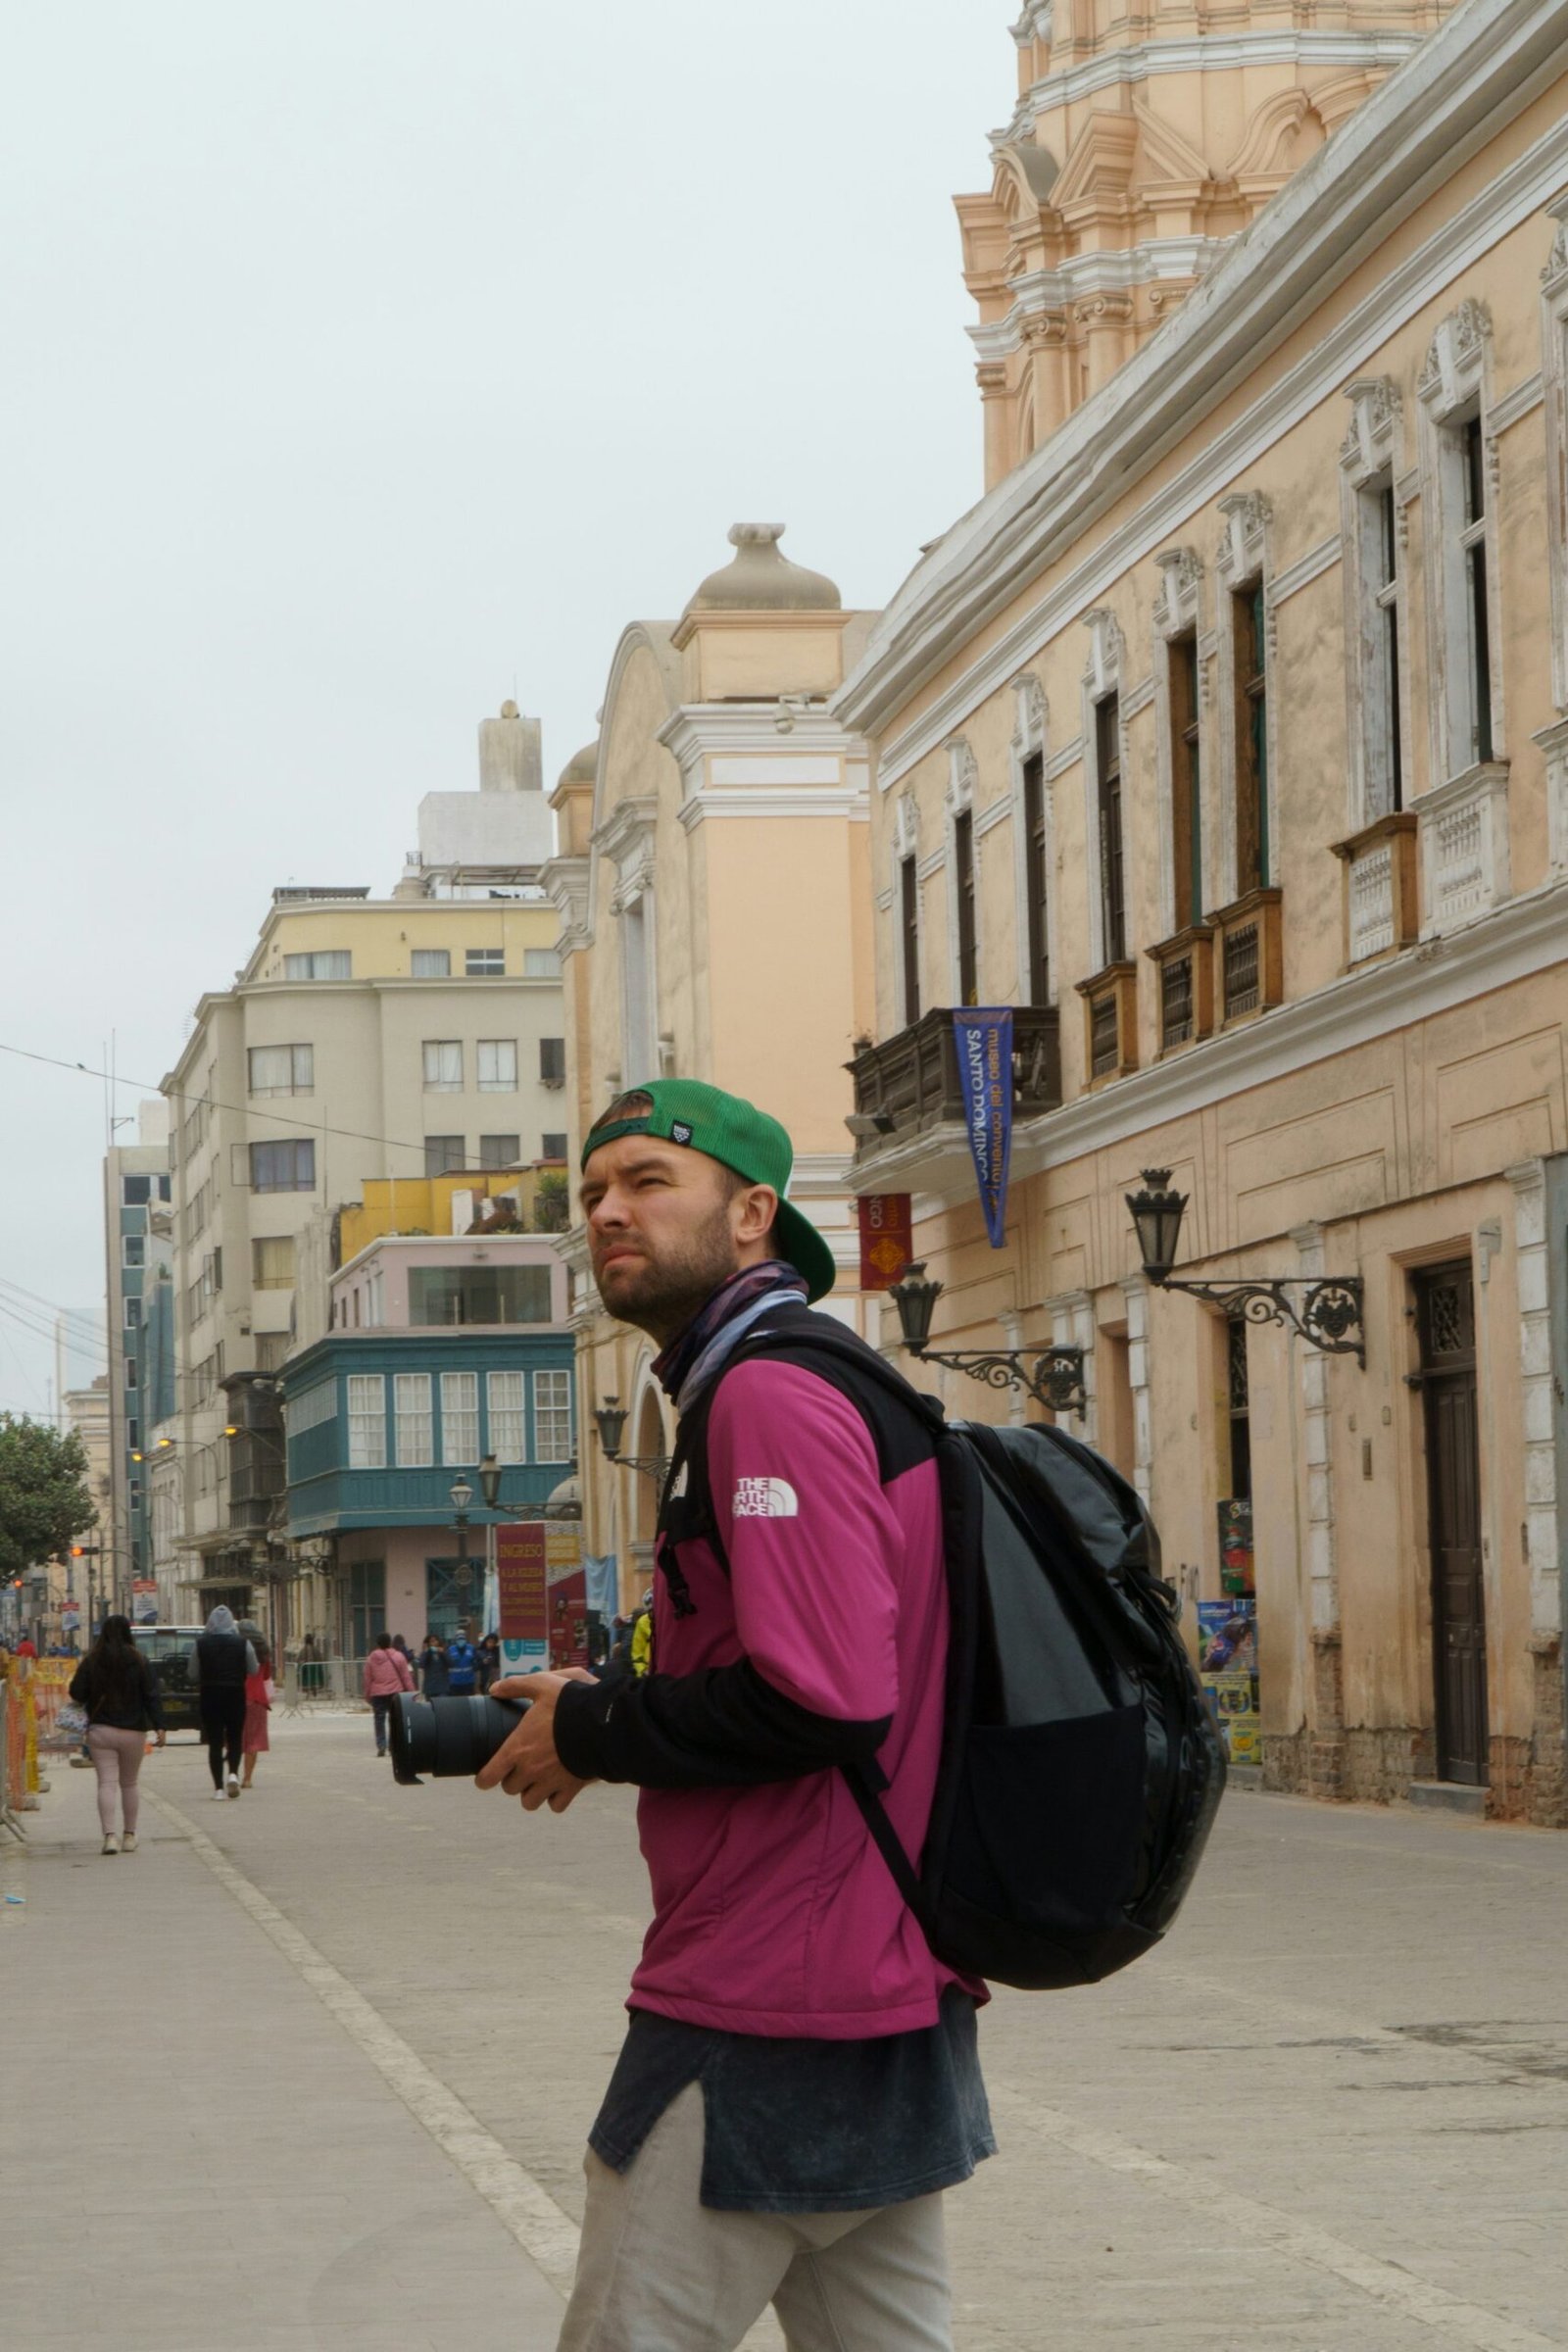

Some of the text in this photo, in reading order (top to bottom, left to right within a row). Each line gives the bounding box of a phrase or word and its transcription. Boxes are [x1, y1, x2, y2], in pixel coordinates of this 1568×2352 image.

[966, 1029, 984, 1092] SANTO
[987, 1028, 1002, 1081] museo
[990, 1084, 1004, 1107] del
[990, 1111, 1004, 1184] convento
[737, 1477, 768, 1491] THE
[500, 1544, 543, 1558] INGRESO
